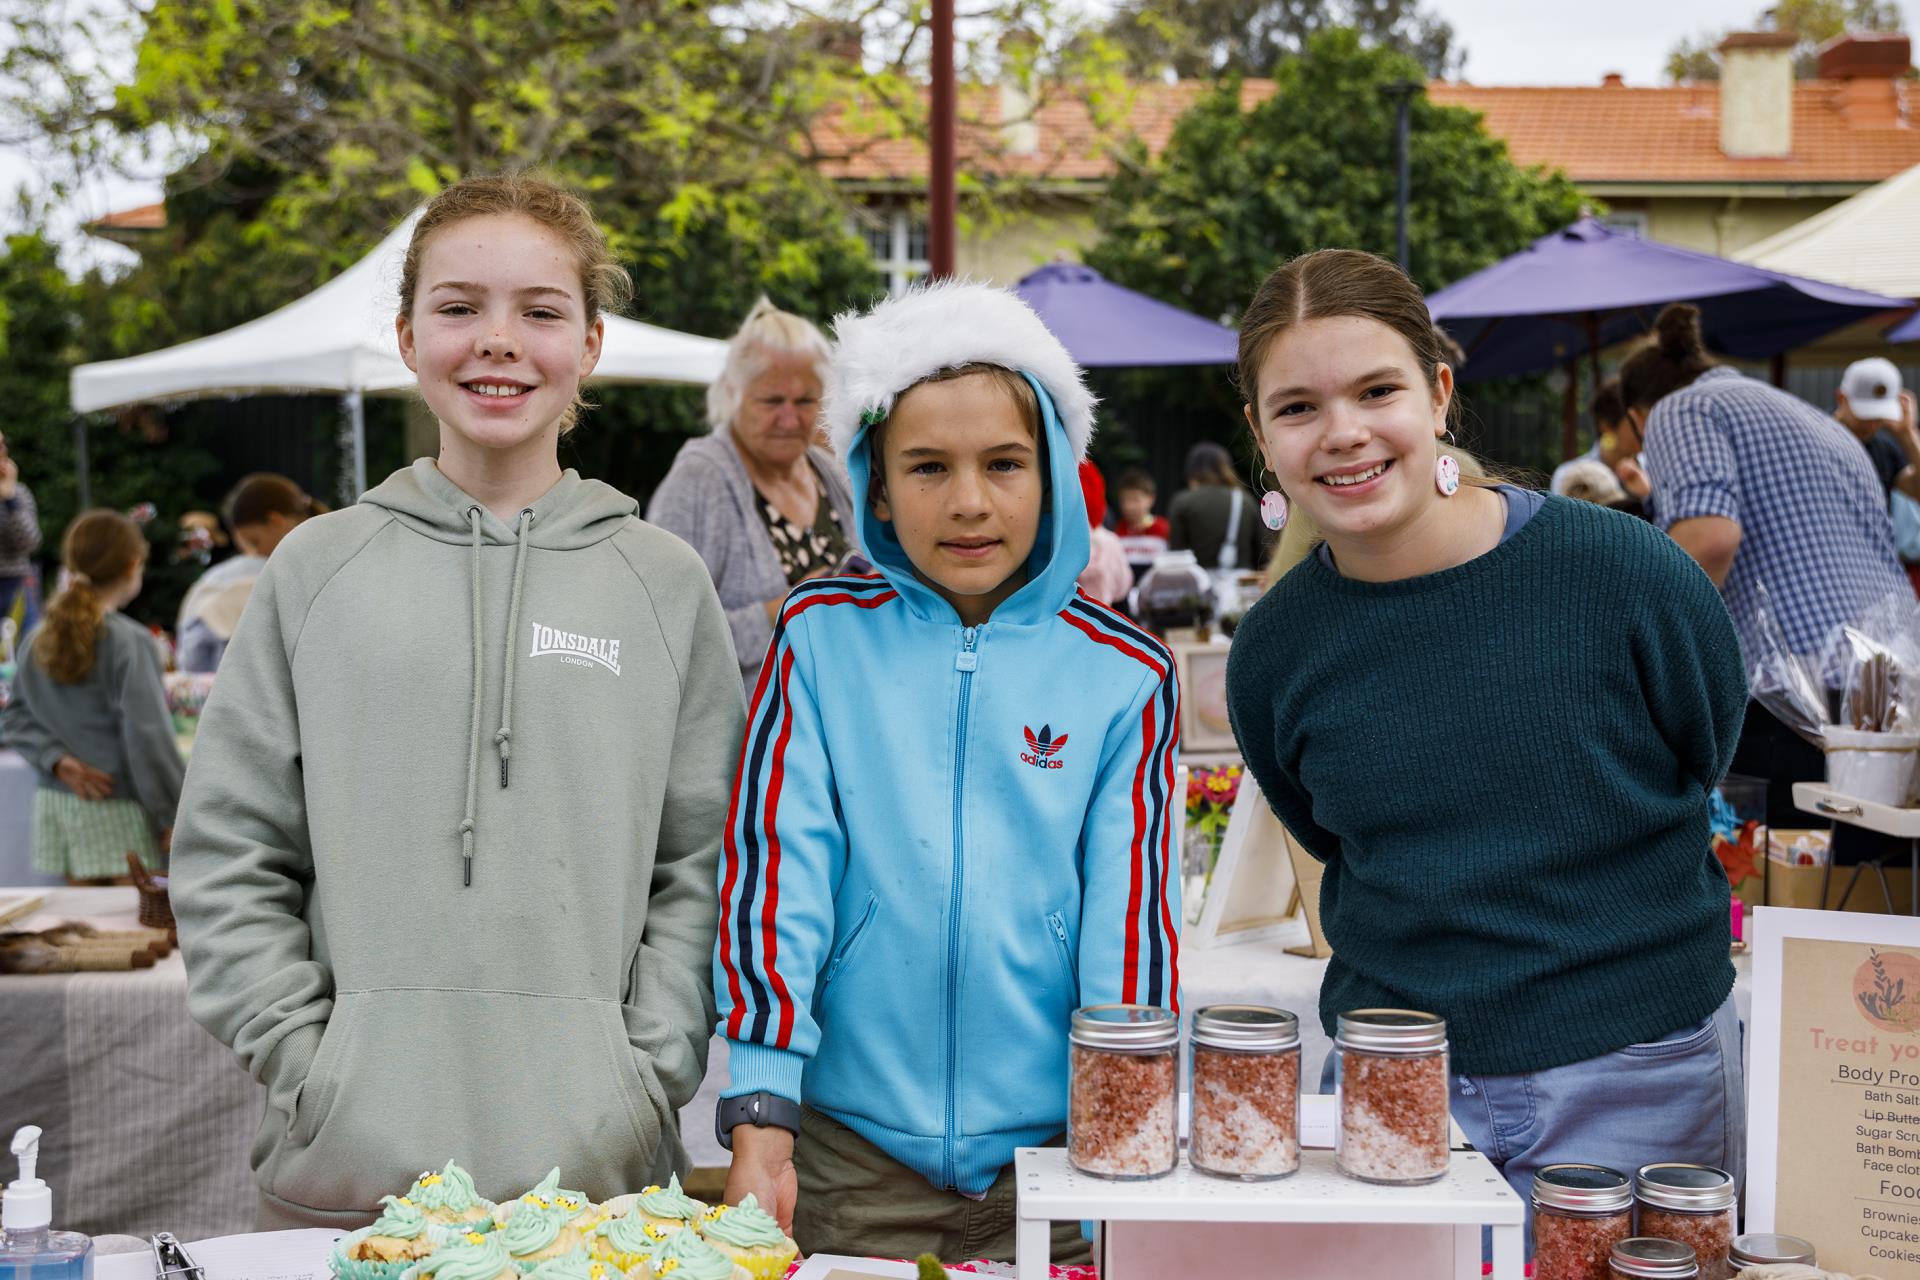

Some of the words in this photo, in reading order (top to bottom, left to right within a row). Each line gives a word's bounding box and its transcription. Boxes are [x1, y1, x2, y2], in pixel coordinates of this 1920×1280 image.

[529, 622, 621, 676] LONSDALE
[560, 655, 594, 669] LONDON
[1020, 752, 1063, 769] adidas
[1809, 1027, 1879, 1055] Treat
[1838, 1064, 1884, 1086] Body
[1864, 1090, 1893, 1103] Bath
[1896, 1093, 1920, 1106] Salt
[1864, 1109, 1884, 1123] Lip
[1856, 1125, 1893, 1140] Sugar
[1856, 1142, 1884, 1155] Bath
[1863, 1159, 1894, 1172] Face
[1863, 1207, 1920, 1225] Brownie
[1861, 1225, 1920, 1243] Cupcake
